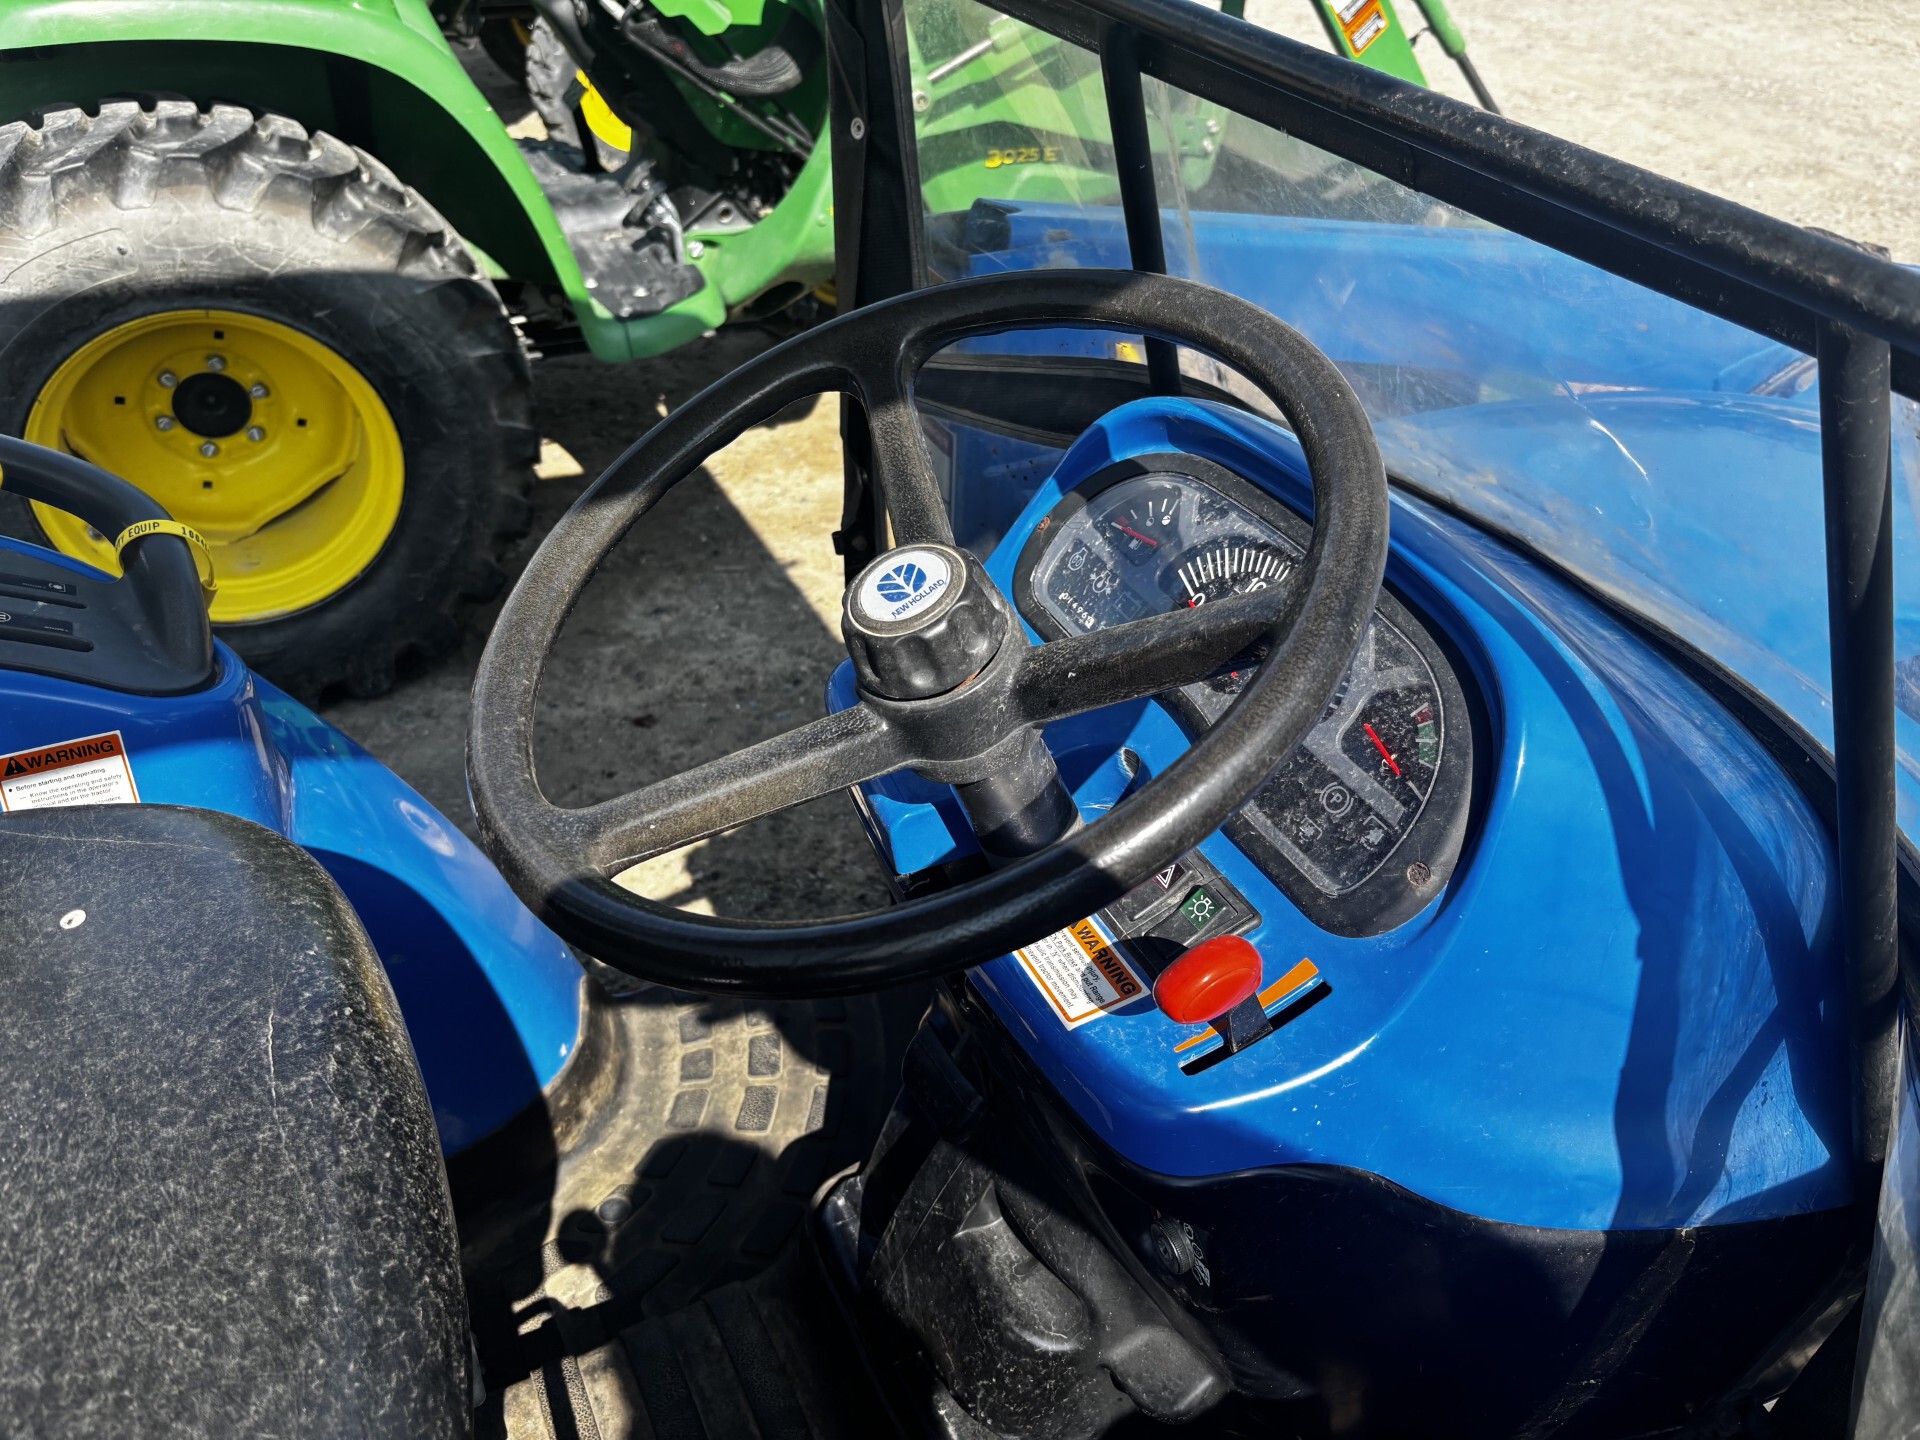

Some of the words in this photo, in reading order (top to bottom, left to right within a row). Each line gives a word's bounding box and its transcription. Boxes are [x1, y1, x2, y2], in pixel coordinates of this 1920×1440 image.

[1043, 147, 1059, 162] E
[128, 521, 160, 538] EQUIP
[891, 602, 910, 618] NEW
[909, 579, 945, 606] HOLLAND
[25, 740, 115, 769] WARNING
[62, 773, 75, 781] and
[1077, 926, 1137, 996] WARNING
[1083, 965, 1102, 983] injury,
[1088, 985, 1107, 1004] Range
